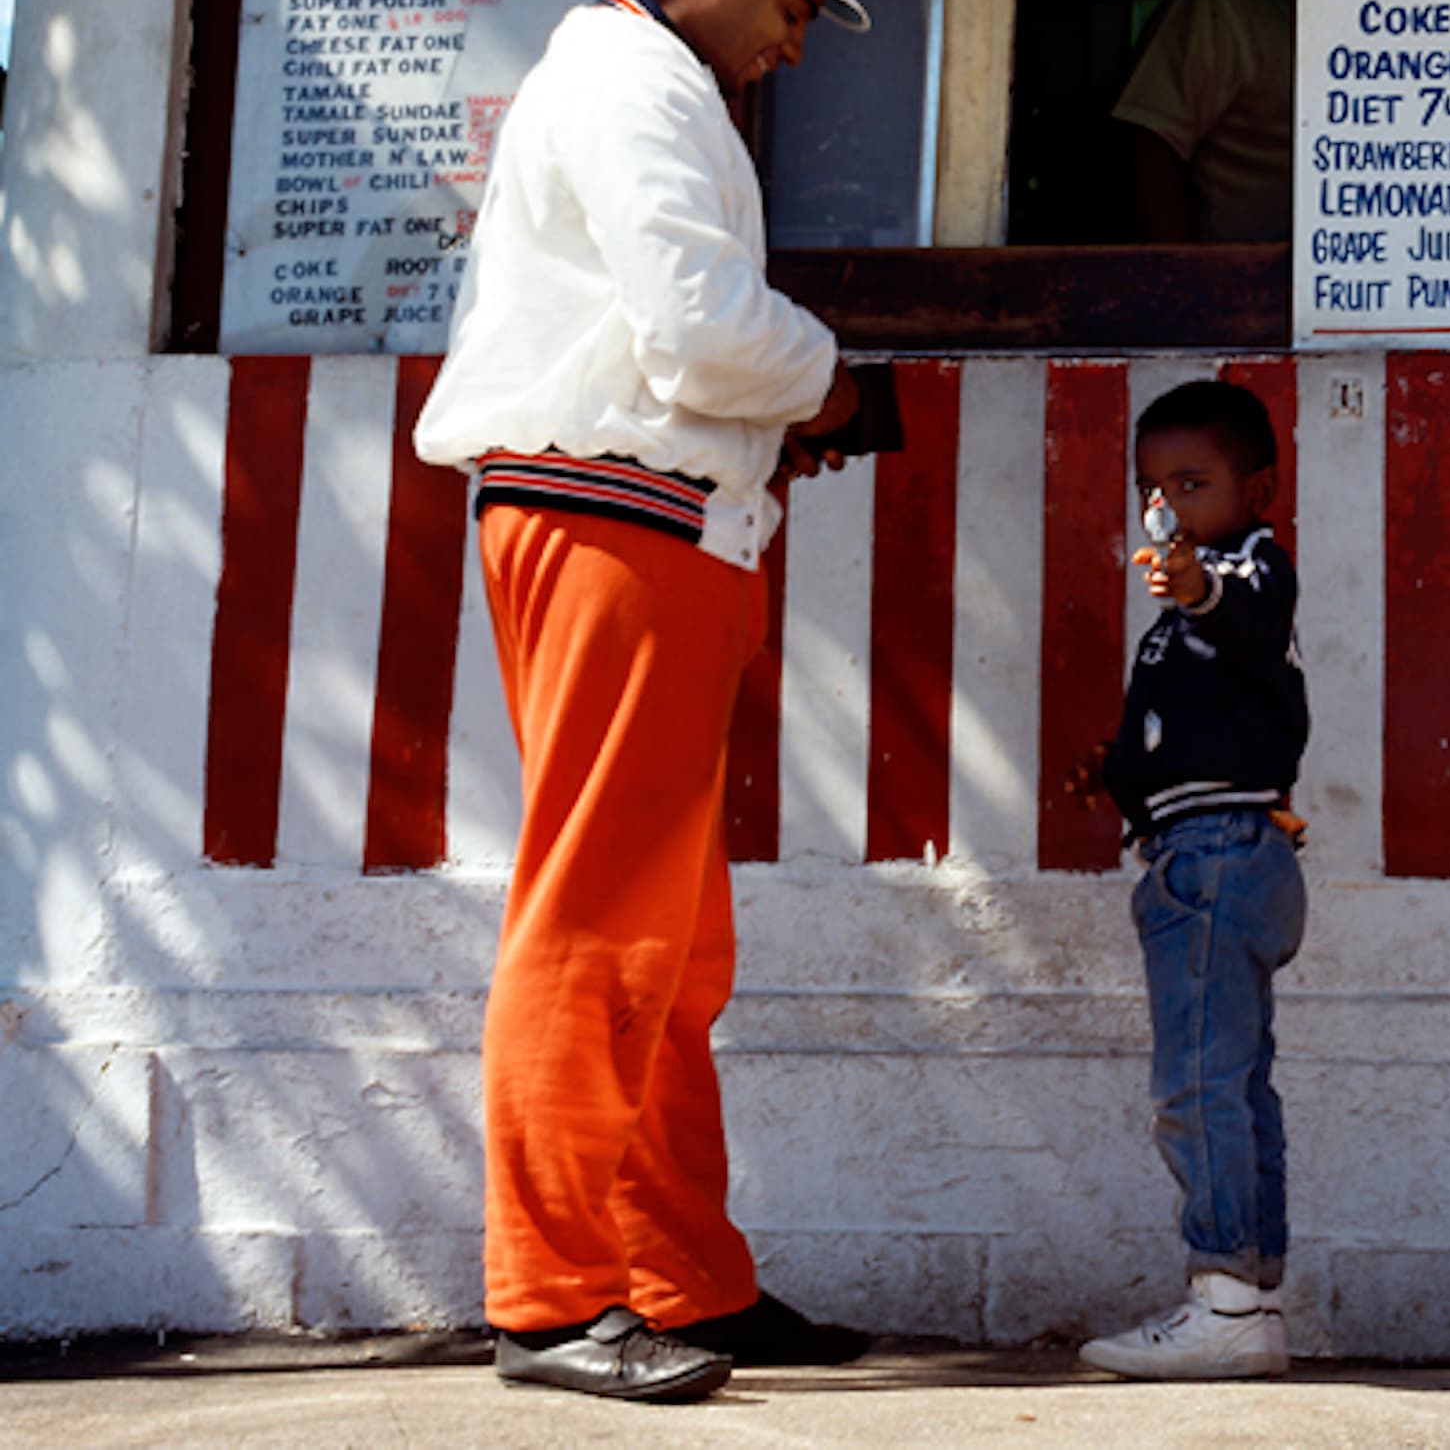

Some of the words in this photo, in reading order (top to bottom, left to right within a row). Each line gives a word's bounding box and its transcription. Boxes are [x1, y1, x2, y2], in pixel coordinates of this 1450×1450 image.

[286, 14, 329, 32] FAT
[337, 12, 380, 31] ONE
[286, 37, 371, 55] CHEESE
[380, 36, 419, 52] FAT
[424, 34, 466, 52] ONE
[283, 59, 344, 77] CHILI
[351, 59, 391, 75] FAT
[398, 58, 443, 75] ONE
[282, 83, 371, 103] TAMALE
[282, 105, 364, 123] TAMALE
[376, 102, 462, 121] SUNDAE
[1327, 90, 1403, 125] DIET
[282, 128, 356, 147] SUPER
[372, 124, 464, 144] SUNDAE
[280, 151, 374, 169] MOTHER
[416, 150, 469, 167] LAW
[276, 176, 340, 195] BOWL
[369, 172, 429, 191] CHILI
[275, 197, 349, 216] CHIPS
[273, 220, 346, 240] SUPER
[356, 218, 395, 236] FAT
[404, 217, 446, 235] ONE
[274, 259, 338, 281] COKE
[385, 257, 443, 276] ROOT
[270, 286, 363, 305] ORANGE
[1314, 273, 1392, 311] FRUIT
[288, 307, 367, 327] GRAPE
[382, 305, 443, 324] JUICE
